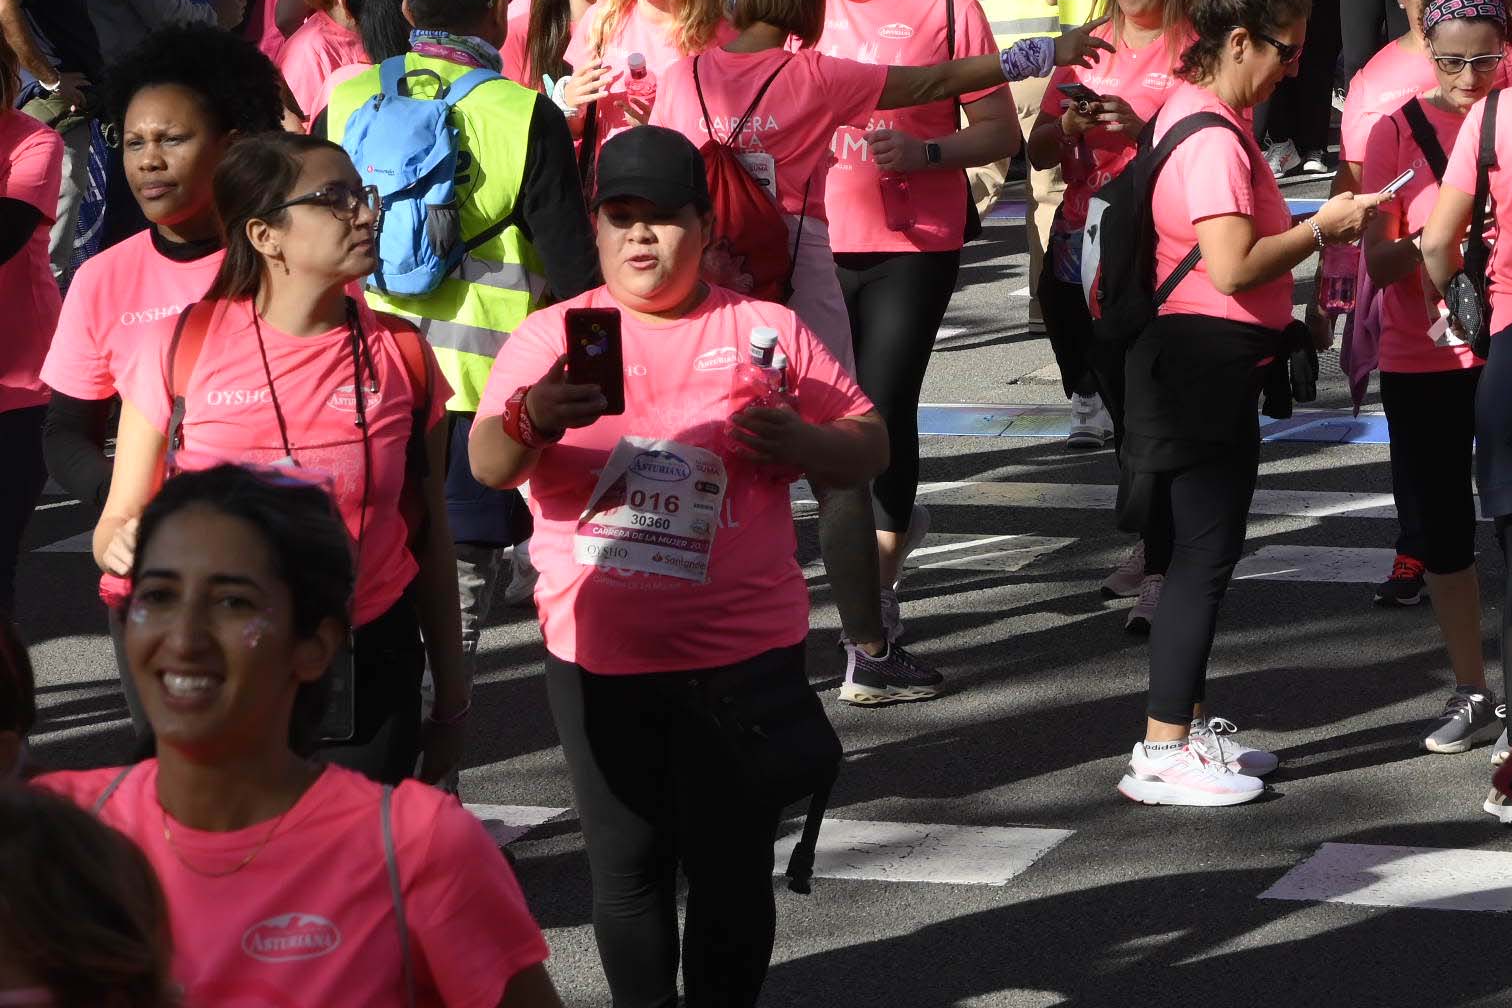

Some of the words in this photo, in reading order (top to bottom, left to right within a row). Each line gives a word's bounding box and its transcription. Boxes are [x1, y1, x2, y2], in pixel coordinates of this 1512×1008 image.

[120, 303, 182, 326] OYSHO
[632, 457, 688, 478] ASTURIANA
[630, 488, 680, 514] 016
[631, 513, 671, 531] 30360
[592, 526, 631, 540] CARRERA
[632, 532, 645, 543] DE
[645, 534, 657, 544] LA
[657, 535, 688, 549] MUJER
[587, 543, 628, 559] OYSHO
